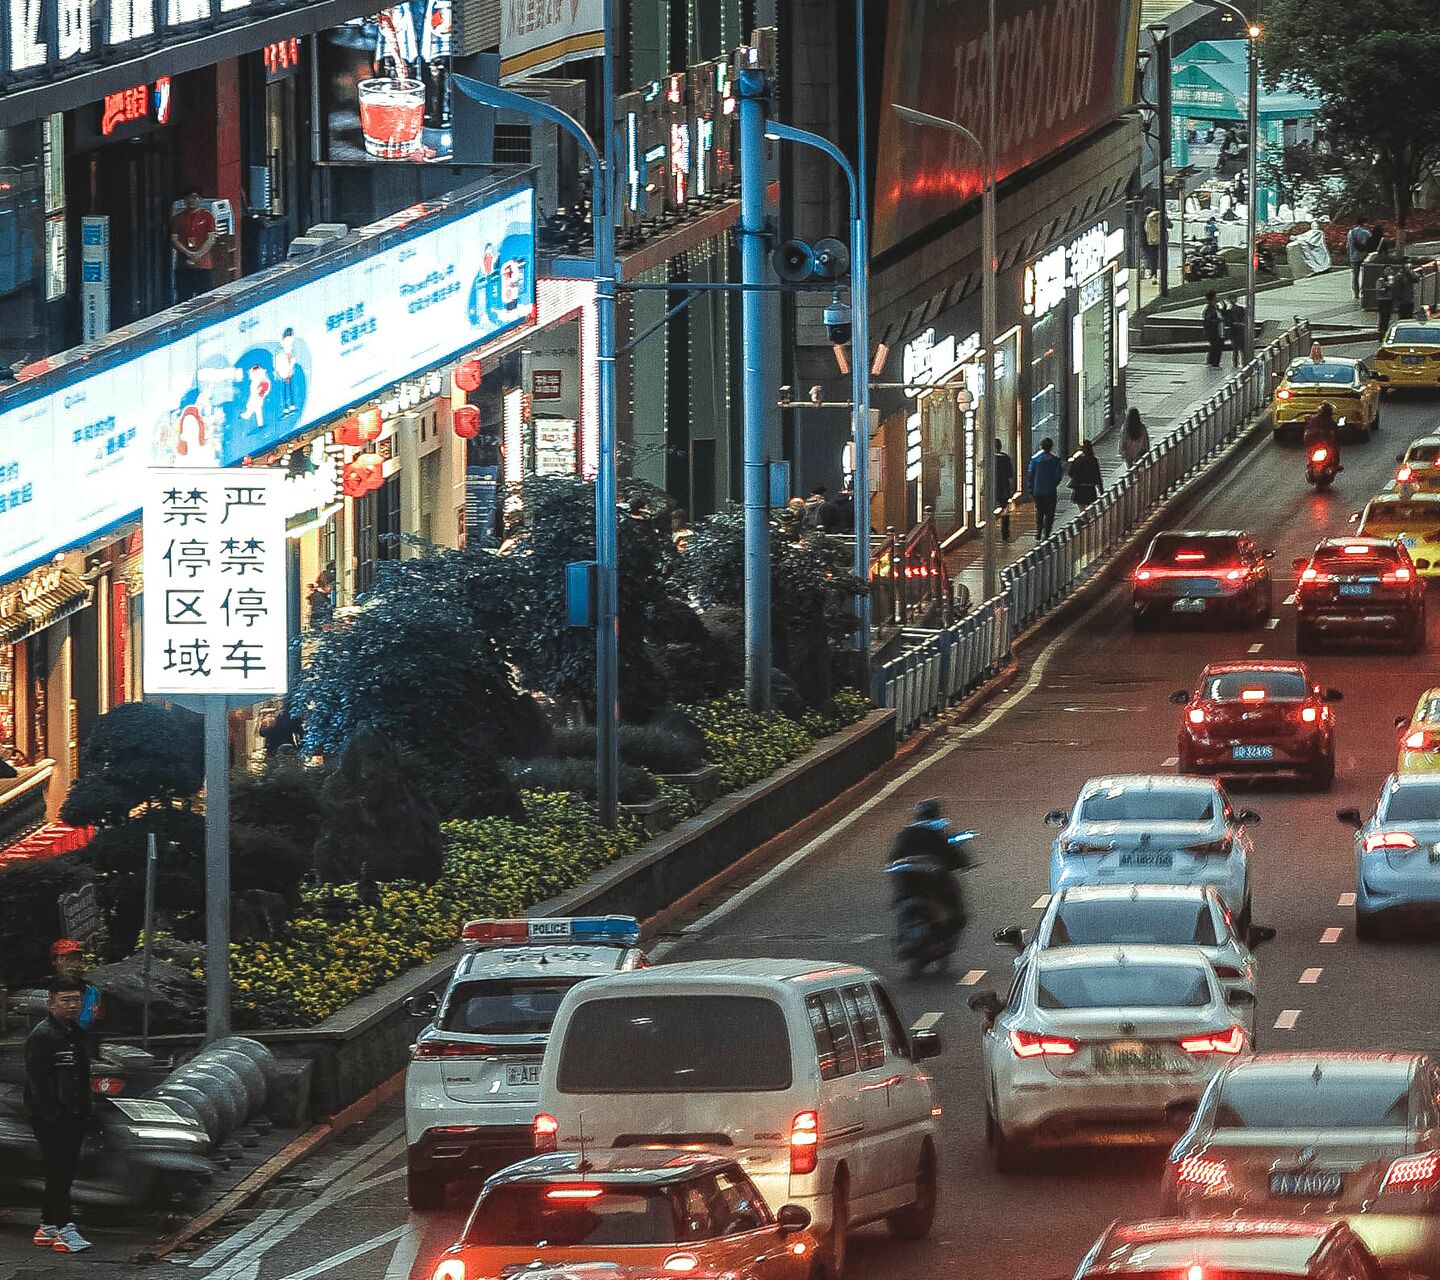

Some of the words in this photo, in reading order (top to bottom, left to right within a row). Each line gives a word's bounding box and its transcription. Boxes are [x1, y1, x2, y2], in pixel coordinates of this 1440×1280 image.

[162, 487, 211, 677] 禁停区域
[219, 486, 269, 679] 严禁停车
[532, 922, 569, 935] POLICE
